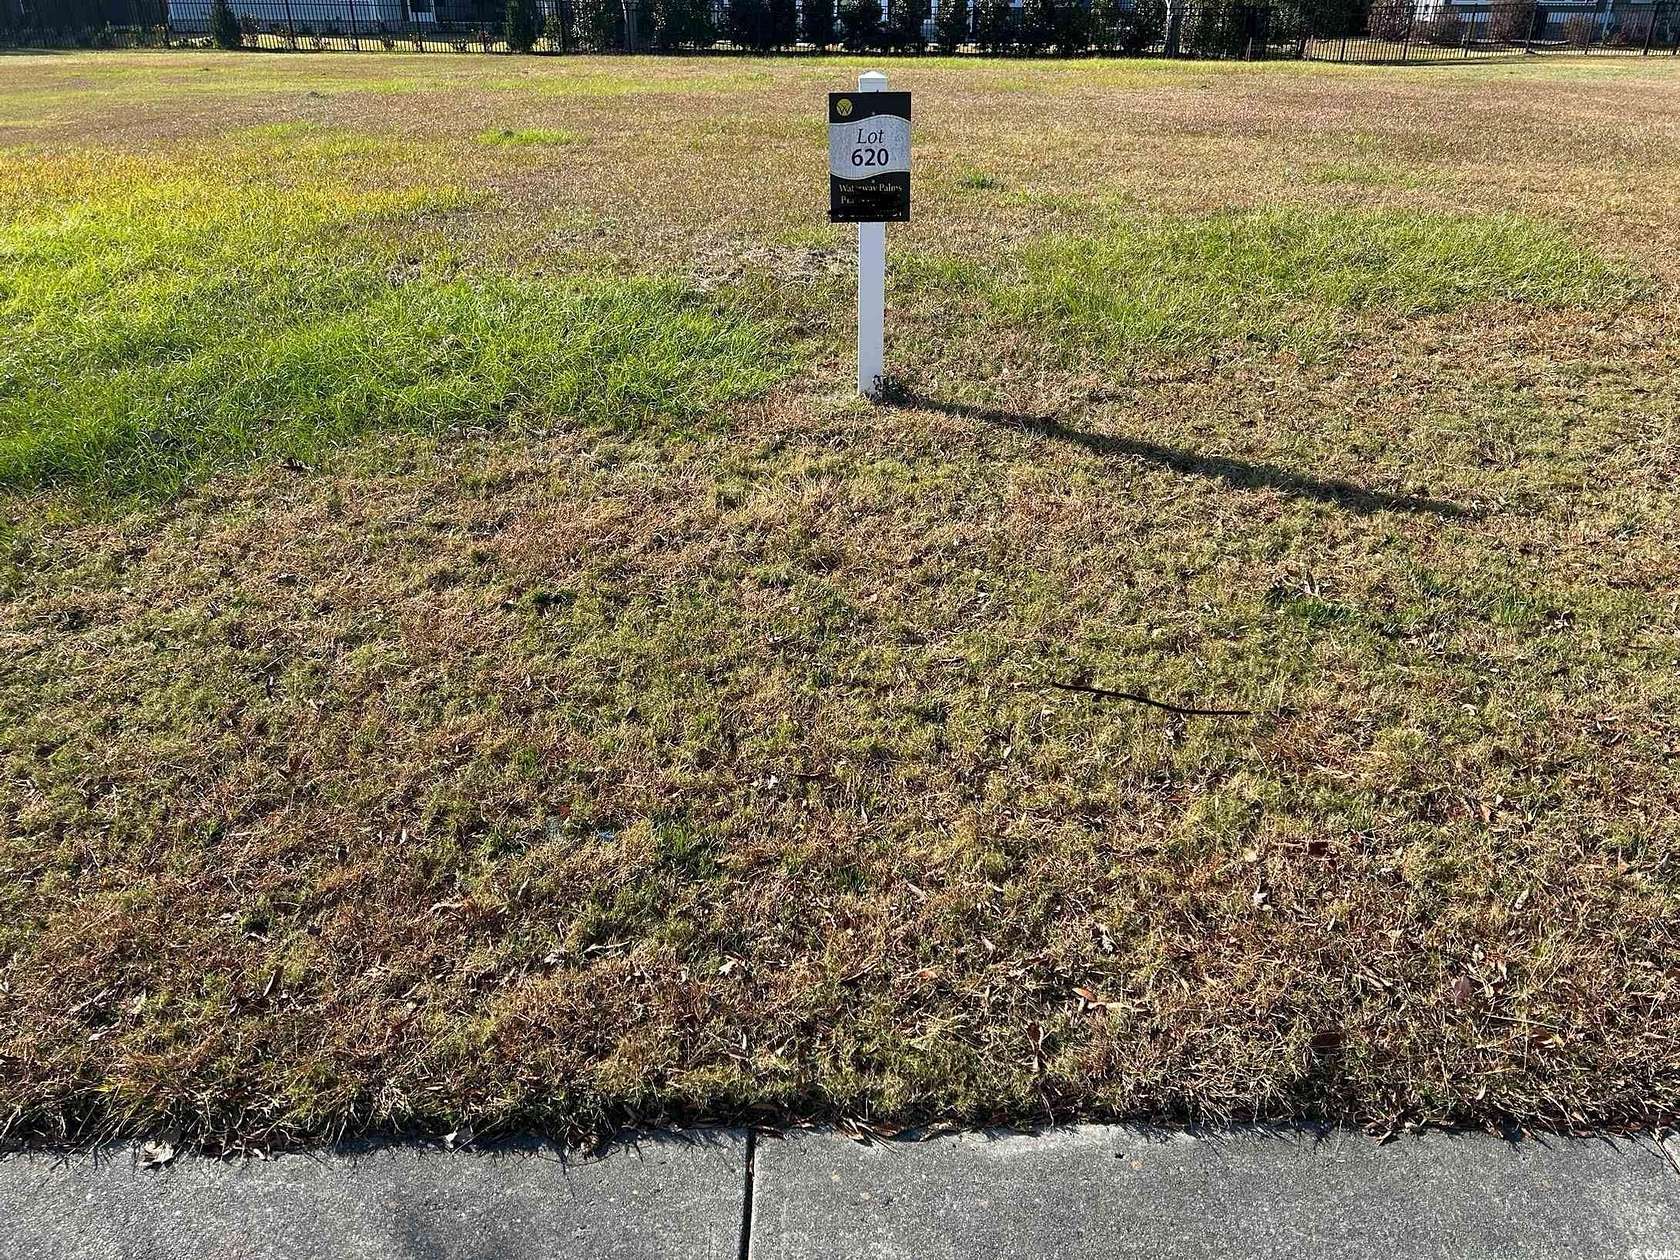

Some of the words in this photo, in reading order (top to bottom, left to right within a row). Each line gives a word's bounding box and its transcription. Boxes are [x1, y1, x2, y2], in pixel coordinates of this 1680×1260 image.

[856, 128, 884, 144] Lot
[851, 148, 889, 166] 620
[838, 184, 878, 193] Watway
[879, 183, 903, 192] Palms
